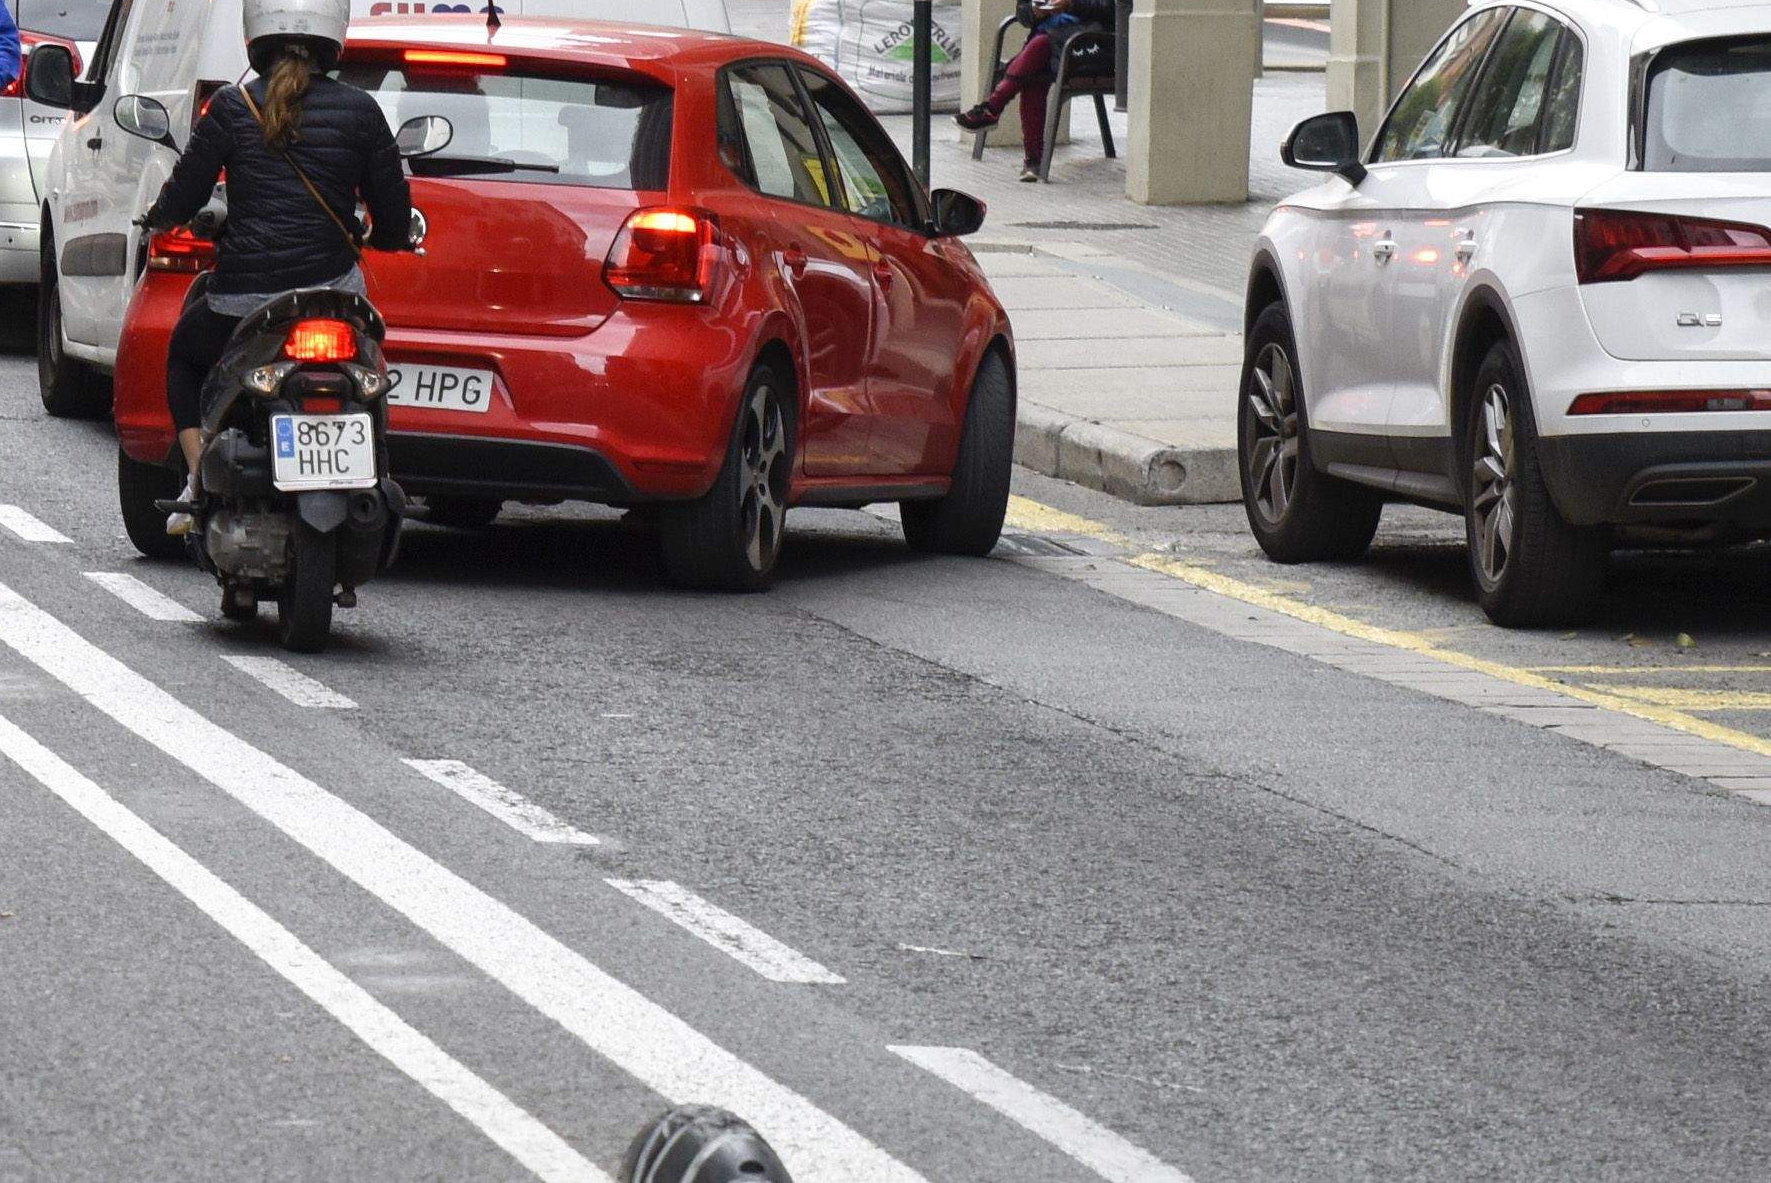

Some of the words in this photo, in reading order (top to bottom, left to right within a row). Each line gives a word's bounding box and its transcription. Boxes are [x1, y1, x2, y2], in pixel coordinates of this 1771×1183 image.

[1676, 312, 1723, 328] Q5
[414, 370, 482, 405] HPG
[281, 441, 289, 452] E
[297, 420, 366, 447] 8673
[299, 449, 350, 475] HHC
